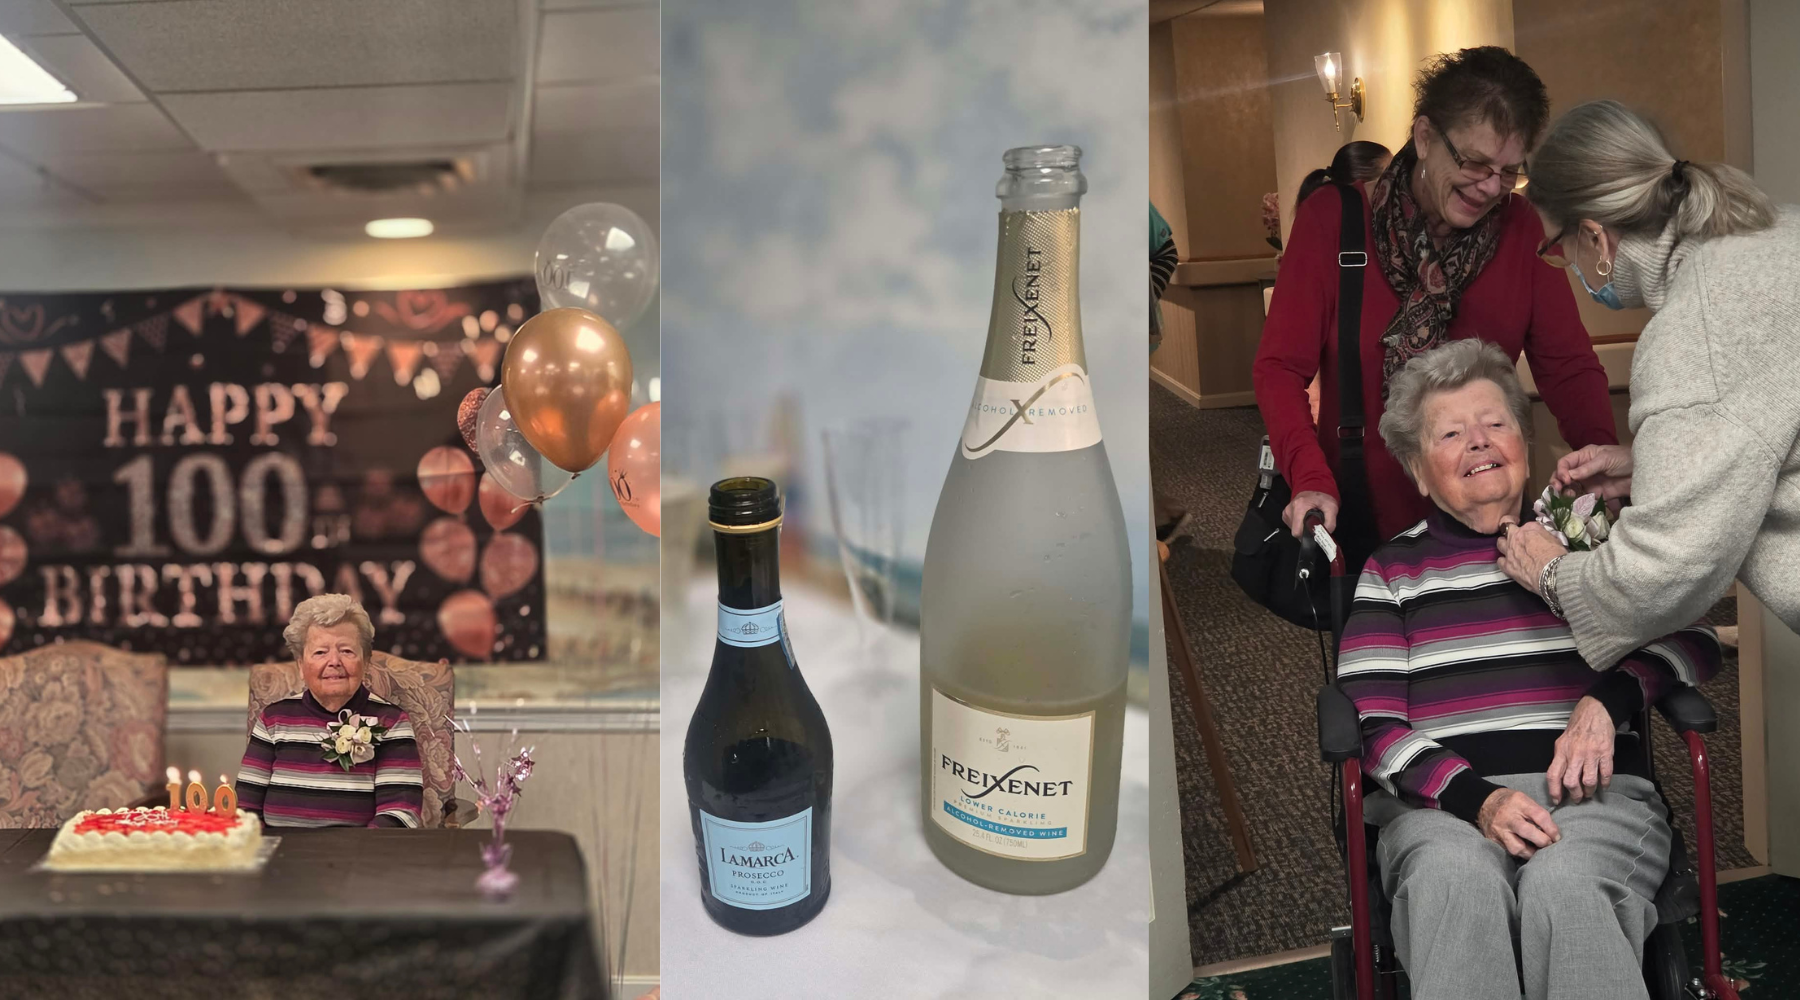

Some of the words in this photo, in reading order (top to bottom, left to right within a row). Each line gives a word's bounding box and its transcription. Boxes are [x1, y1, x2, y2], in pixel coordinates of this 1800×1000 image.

[1011, 247, 1052, 365] FREIXENET
[102, 381, 349, 447] HAPPY
[1028, 404, 1088, 417] REMOVED
[111, 450, 308, 557] 100
[941, 754, 1074, 799] FREIXENET
[165, 781, 238, 817] 100
[953, 799, 992, 819] PREMIUM
[997, 816, 1052, 826] SPARKLING
[960, 795, 994, 812] LOWER
[998, 808, 1047, 820] CALORIE
[946, 805, 1035, 837] ALCOHOL-REMOVED
[1039, 829, 1064, 837] WINE
[730, 883, 768, 892] SPARKLING
[770, 883, 788, 891] WINE
[732, 870, 785, 880] PROSECCO
